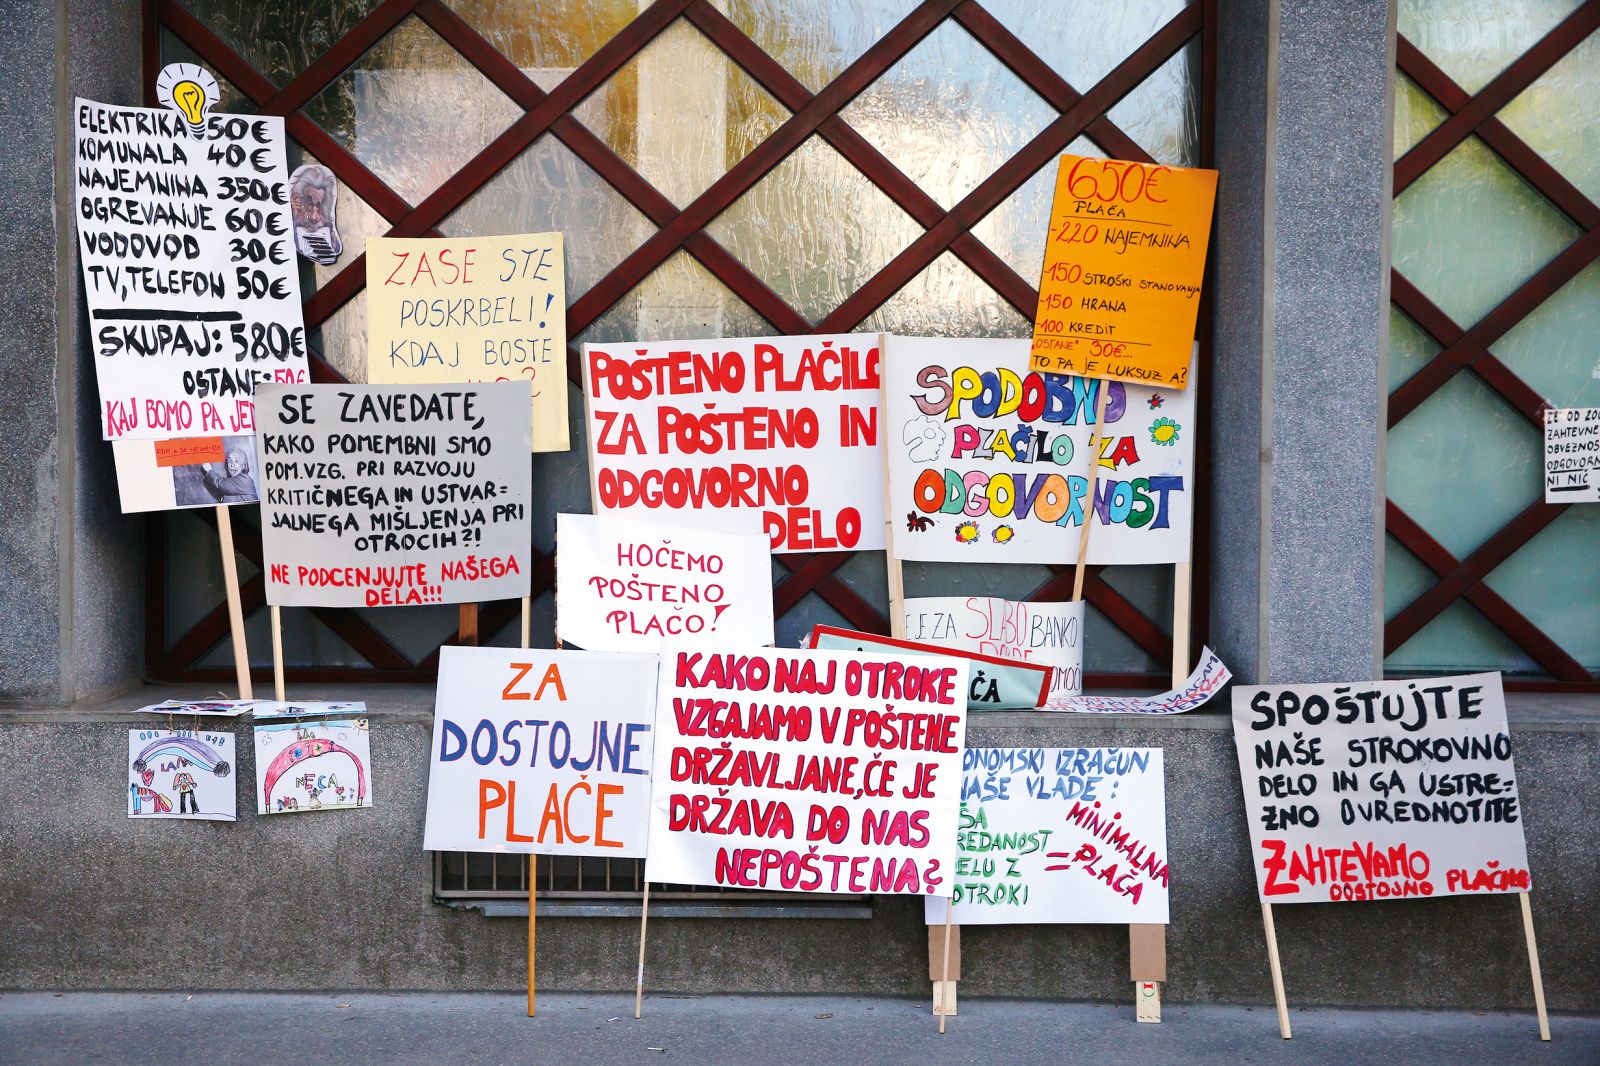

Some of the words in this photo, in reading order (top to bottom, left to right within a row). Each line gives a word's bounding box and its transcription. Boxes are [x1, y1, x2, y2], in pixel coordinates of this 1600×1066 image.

[79, 105, 187, 138] ELEKTRIKA
[207, 117, 273, 144] 50€
[79, 138, 188, 165] KOMUNALA
[207, 143, 277, 173] 40€
[78, 166, 209, 199] NAJEMNINA
[217, 177, 290, 205] 350€
[1067, 157, 1172, 203] 650€
[81, 197, 217, 231] OGREVANJE
[225, 208, 289, 236] 60€
[1072, 200, 1126, 219] PLAČA
[83, 231, 200, 261] VODOVOD
[229, 238, 290, 265] 30€
[1051, 221, 1099, 244] -220
[1104, 227, 1191, 255] NAJEMNINA
[236, 266, 291, 300] 50€
[385, 248, 477, 287] ZASE
[499, 247, 553, 282] STE
[400, 293, 555, 329] POSKRBELI!
[1081, 297, 1126, 313] HRANA
[98, 322, 223, 358] SKUPAJ:
[230, 321, 305, 362] 580€
[1069, 321, 1116, 335] KREDIT
[389, 339, 460, 368] KDAJ
[484, 337, 552, 366] BOSTE
[1032, 354, 1051, 369] TO
[1057, 357, 1074, 370] PA
[1106, 362, 1162, 382] LUKSUZ
[589, 349, 746, 401] POŠTENO
[278, 394, 316, 425] SE
[337, 391, 485, 431] ZAVEDATE,
[910, 365, 1127, 426] SPODOBNO
[106, 397, 139, 437] KAJ
[145, 399, 193, 432] BOMO
[200, 401, 225, 432] PA
[594, 410, 647, 455] ZA
[657, 403, 820, 455] POŠTENO
[840, 405, 877, 448] IN
[1547, 425, 1599, 440] ZAHTEVNE
[1567, 411, 1580, 422] OD
[263, 433, 315, 455] KAKO
[327, 434, 437, 456] POMEMBNI
[446, 435, 492, 457] SMO
[1088, 433, 1141, 472] ZA
[356, 460, 385, 477] PRI
[393, 461, 476, 479] RAZVOJU
[599, 463, 809, 509] ODGOVORNO
[1547, 475, 1559, 488] NI
[1568, 469, 1588, 485] NIČ
[267, 484, 390, 510] KRITIČNEGA
[394, 486, 413, 502] IN
[913, 468, 1185, 531] ODGOVORNOST
[271, 512, 360, 537] JALNEGA
[370, 505, 487, 531] MIŠLJENJA
[492, 503, 525, 523] PRI
[763, 506, 862, 550] DELO
[270, 563, 290, 586] NE
[297, 563, 428, 588] PODCENJUJTE
[441, 554, 521, 582] NAŠEGA
[617, 539, 723, 575] HOČEMO
[365, 585, 443, 607] DELA!!!
[589, 573, 724, 603] POŠTENO
[606, 604, 732, 637] PLAČO!
[1029, 614, 1079, 648] BANKO
[501, 662, 567, 701] ZA
[675, 651, 770, 691] KAKO
[773, 658, 837, 695] NAJ
[844, 659, 958, 705] OTROKE
[672, 697, 813, 741] VZGAJAMO
[820, 706, 841, 744] V
[843, 703, 960, 754] POŠTENE
[1250, 683, 1484, 732] SPOŠTUJTE
[439, 718, 651, 775] DOSTOJNE
[1055, 748, 1150, 776] IZRAČUN
[1255, 732, 1324, 770] NAŠE
[1348, 732, 1512, 768] STROKOVNO
[902, 762, 939, 799] JE
[1258, 773, 1318, 799] DELO
[1332, 771, 1359, 793] IN
[1370, 769, 1406, 799] GA
[478, 774, 624, 848] PLAČE
[669, 787, 794, 839] DRŽAVA
[806, 804, 850, 844] DO
[861, 808, 930, 849] NAS
[1066, 801, 1169, 888] MINIMALNA
[715, 845, 943, 894] NEPOŠTENA?
[1006, 858, 1022, 877] Z
[1261, 839, 1431, 897] ZAHTEVAMO
[952, 883, 1029, 907] OTROKI
[1329, 881, 1434, 901] DOSTOJNO
